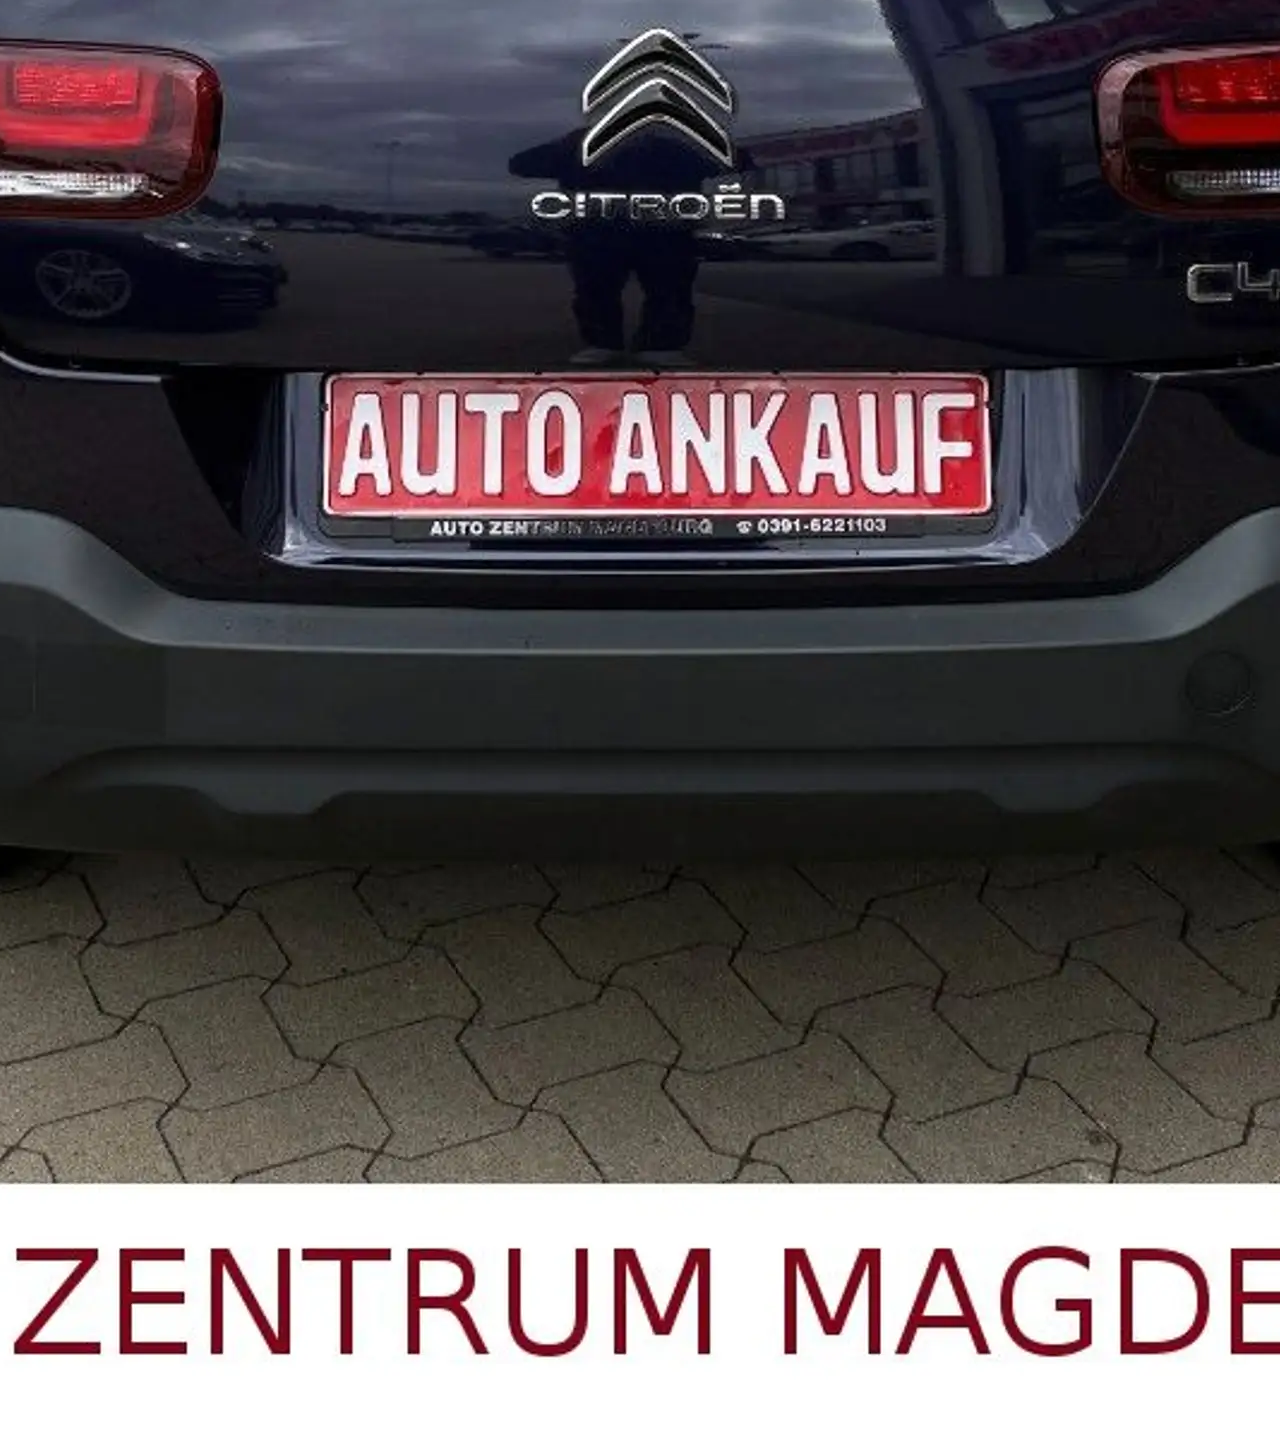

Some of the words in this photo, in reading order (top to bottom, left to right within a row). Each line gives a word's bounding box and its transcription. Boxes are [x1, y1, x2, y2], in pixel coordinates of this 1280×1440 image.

[531, 182, 786, 221] CITROËN
[338, 390, 583, 497] AUTO
[609, 390, 976, 497] ANKAUF
[430, 520, 485, 536] AUTO
[757, 517, 887, 534] 0391-6221103
